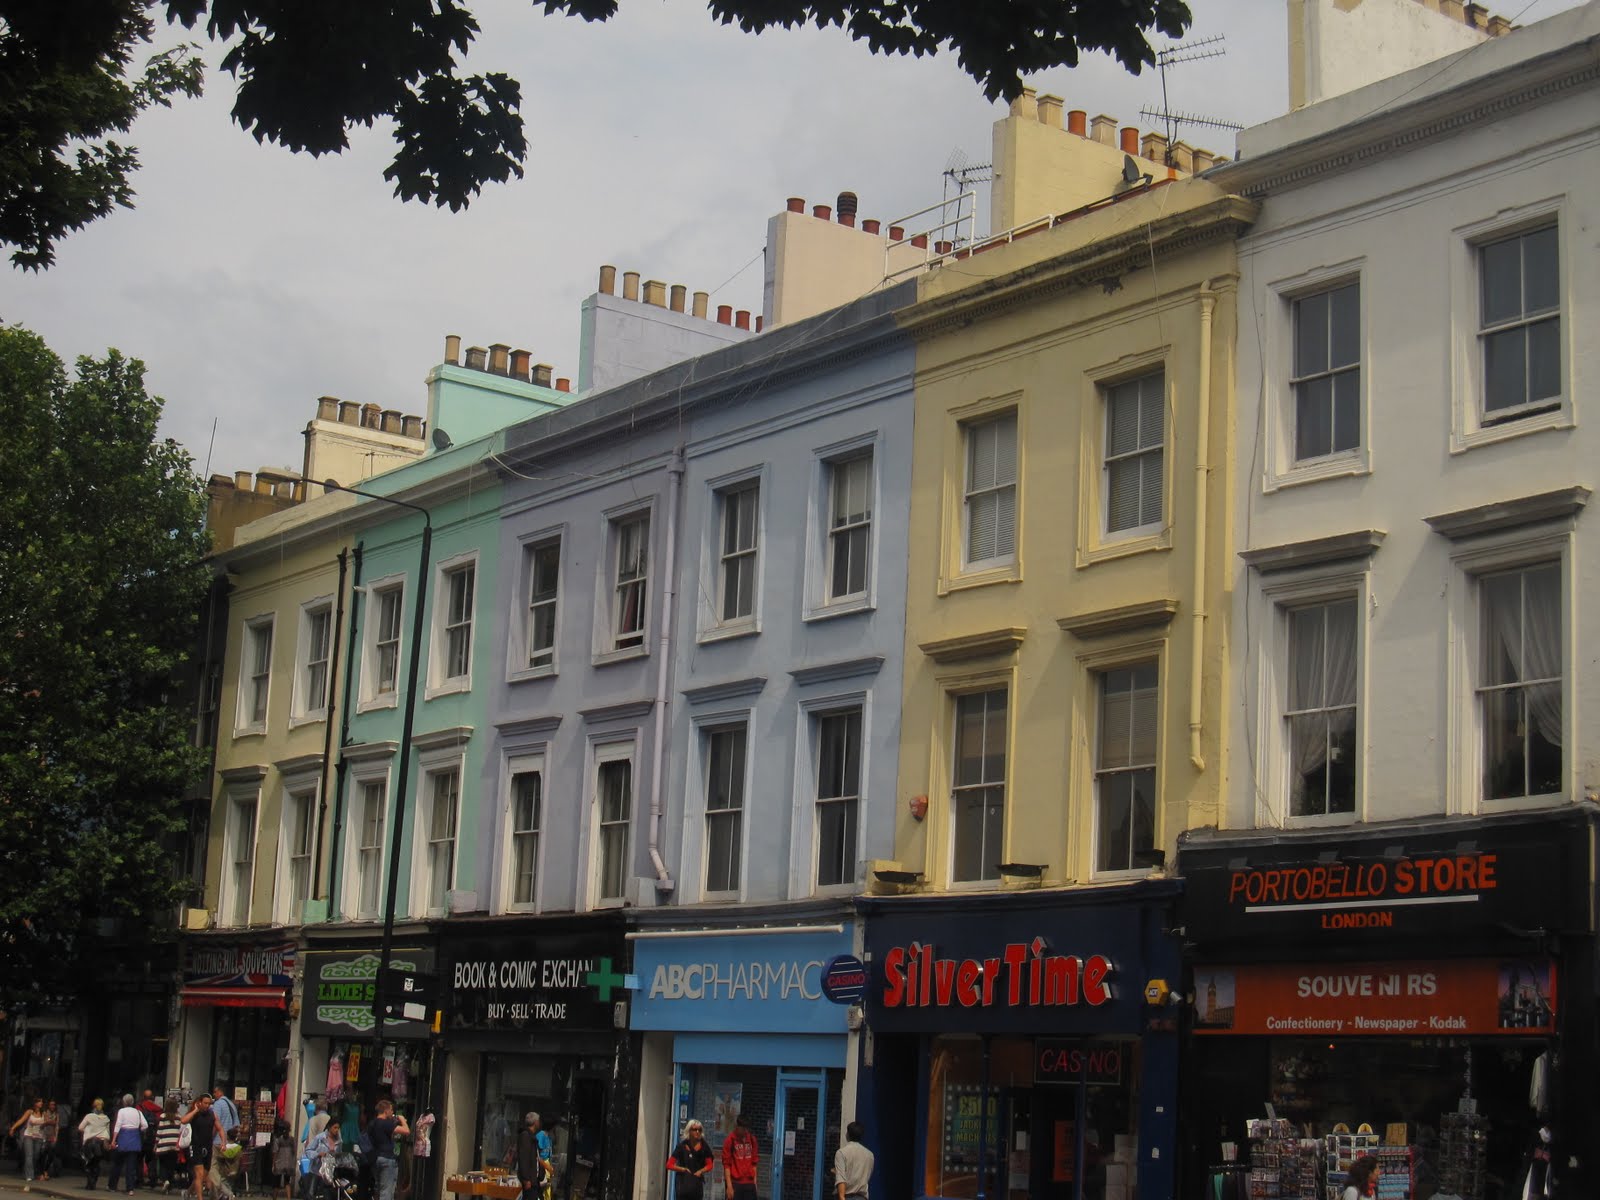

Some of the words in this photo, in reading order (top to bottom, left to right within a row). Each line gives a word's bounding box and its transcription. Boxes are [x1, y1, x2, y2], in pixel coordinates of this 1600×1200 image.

[1229, 863, 1387, 903] PORTOBELLO
[1394, 854, 1497, 894] STORE
[1322, 911, 1393, 929] LONDON
[241, 951, 284, 975] SOUVENIRS
[454, 962, 486, 988] BOOK
[488, 961, 497, 988] &
[500, 960, 537, 988] COMIC
[542, 960, 593, 988] EXCHA
[827, 974, 865, 987] CASINO
[487, 1003, 505, 1019] BUY
[511, 1003, 529, 1019] SELL
[535, 1003, 566, 1019] TRADE
[1266, 1015, 1343, 1031] Confectionery
[1354, 1015, 1418, 1031] Newspaper
[1429, 1015, 1466, 1029] Kodak
[1041, 1049, 1120, 1073] CASNO
